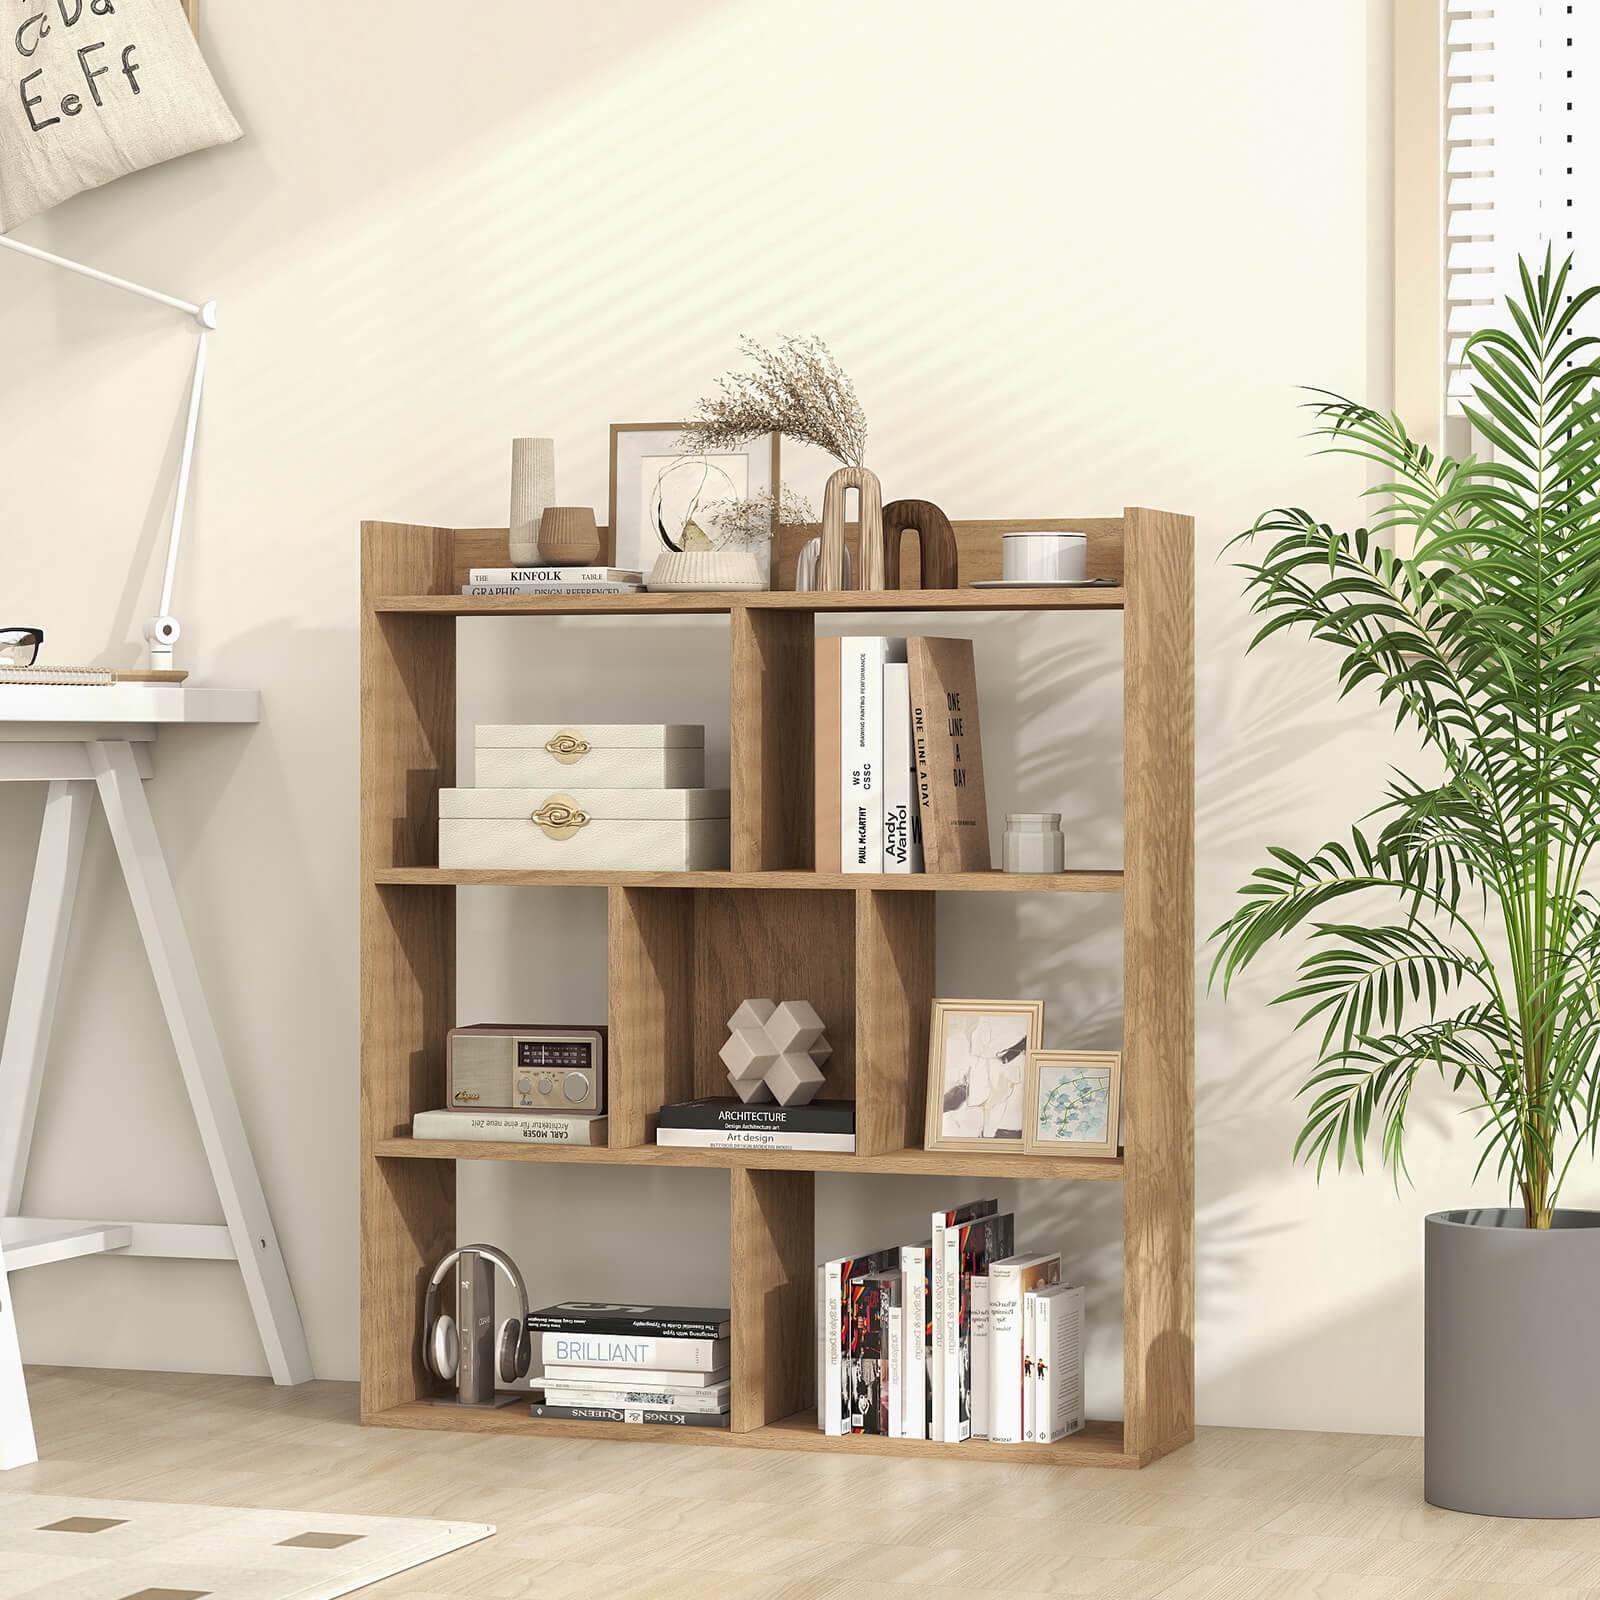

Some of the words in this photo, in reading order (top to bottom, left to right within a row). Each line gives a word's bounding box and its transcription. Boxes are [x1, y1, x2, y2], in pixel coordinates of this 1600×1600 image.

[510, 571, 562, 581] KINFOLK
[581, 573, 603, 581] TABLE
[472, 587, 520, 596] GRAPHIC
[947, 692, 961, 711] ONE
[914, 707, 924, 732] ONE
[948, 718, 964, 737] LINE
[916, 738, 927, 766] LINE
[955, 743, 961, 762] A
[852, 770, 860, 786] WS
[863, 763, 871, 790] CSSC
[919, 772, 927, 780] A
[953, 769, 967, 788] DAY
[921, 783, 930, 808] DAY
[885, 811, 899, 857] Andy
[896, 804, 907, 864] Warhol
[858, 845, 867, 864] PAUL
[718, 1110, 787, 1122] ARCHITECTURE
[471, 1119, 485, 1128] Zeit
[486, 1119, 503, 1127] neue
[504, 1120, 519, 1128] eine
[519, 1121, 530, 1129] für
[532, 1121, 569, 1130] Architektur
[724, 1122, 741, 1130] Design
[522, 1129, 548, 1138] MOSER
[550, 1130, 569, 1139] CARL
[726, 1132, 741, 1141] Art
[743, 1133, 774, 1143] design
[689, 1330, 719, 1339] Designing
[556, 1340, 649, 1363] BRILLIANT
[571, 1408, 624, 1422] QUEENS
[644, 1411, 685, 1424] KINGS
